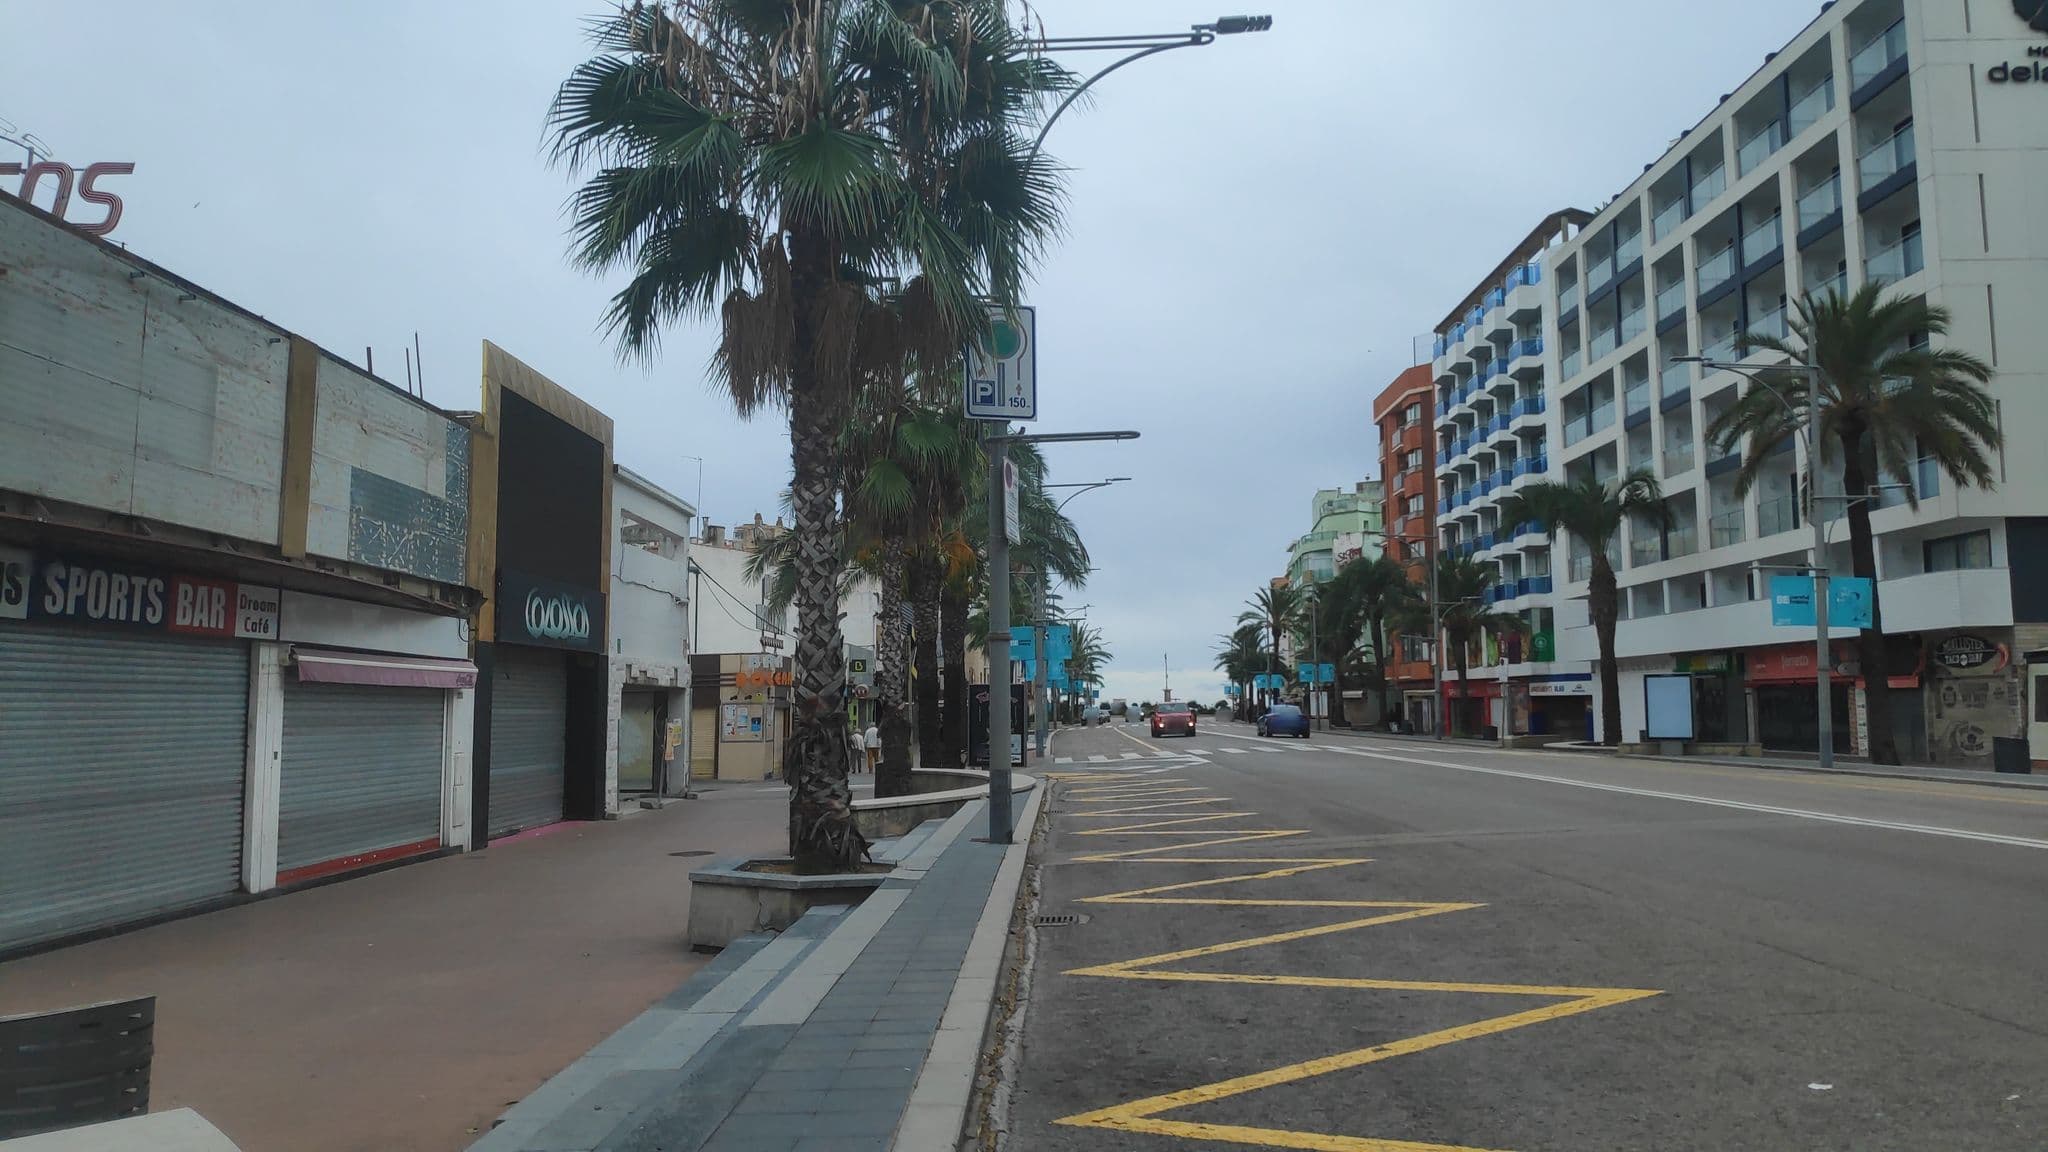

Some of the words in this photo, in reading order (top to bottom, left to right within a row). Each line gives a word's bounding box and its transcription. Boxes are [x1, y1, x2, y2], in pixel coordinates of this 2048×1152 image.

[974, 382, 993, 403] P
[1008, 397, 1026, 408] 150
[44, 563, 163, 624] SPORTS
[176, 583, 226, 630] BAR
[240, 593, 277, 613] Dream
[244, 617, 269, 634] Café
